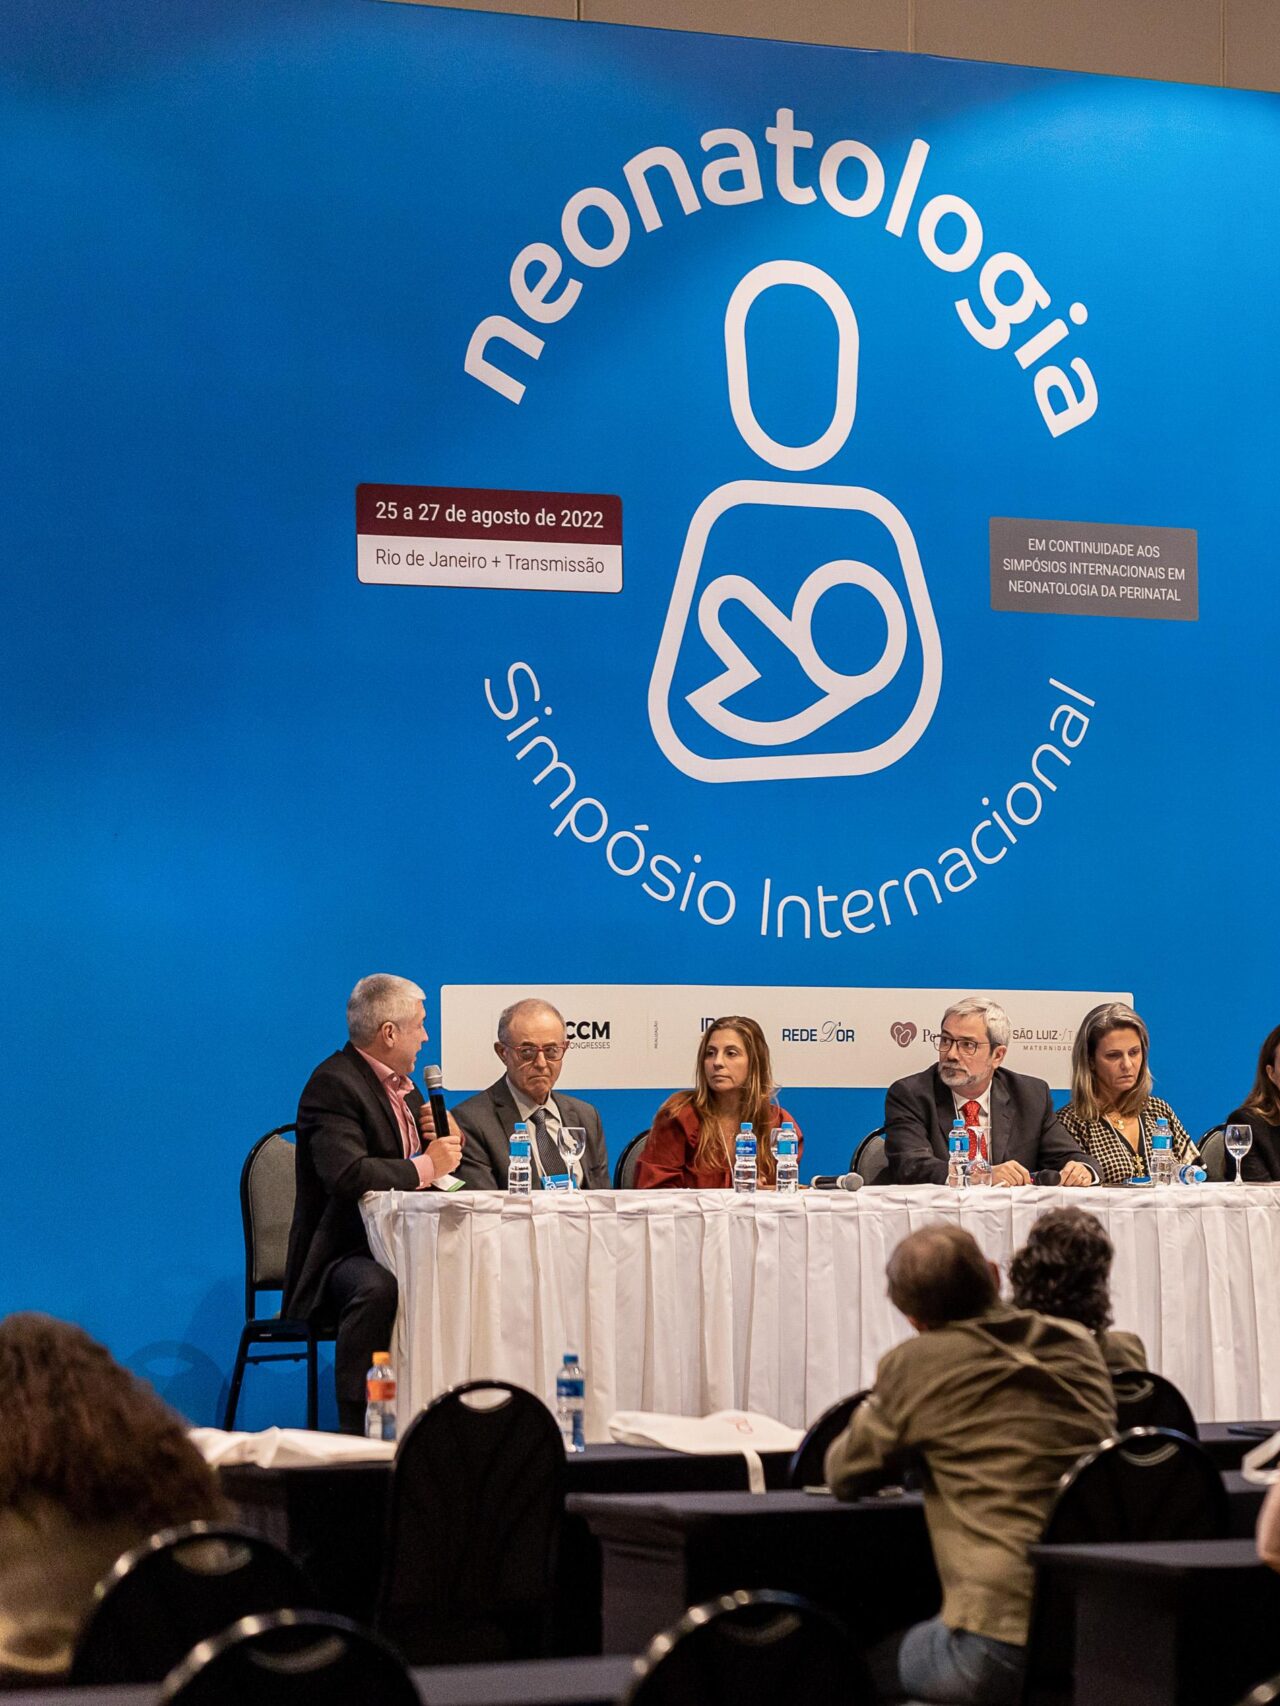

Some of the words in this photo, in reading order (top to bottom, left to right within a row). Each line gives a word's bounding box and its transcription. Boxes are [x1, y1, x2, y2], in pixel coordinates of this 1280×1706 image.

[464, 108, 1098, 438] neonatologia
[375, 502, 398, 519] 25
[403, 507, 413, 520] a
[418, 504, 440, 521] 27
[445, 504, 467, 523] de
[471, 509, 531, 528] agosto
[535, 508, 556, 526] de
[561, 510, 604, 528] 2022
[1028, 538, 1046, 551] EM
[1048, 539, 1134, 556] CONTINUIDADE
[1136, 545, 1160, 558] AOS
[375, 549, 401, 566] Rio
[405, 550, 425, 566] de
[429, 550, 487, 568] Janeiro
[492, 556, 502, 568] +
[505, 553, 605, 574] Transmissão
[1003, 557, 1067, 574] SIMPÓSIOS
[1069, 562, 1165, 580] INTERNACIONAIS
[1168, 567, 1185, 581] EM
[1008, 580, 1098, 597] NEONATOLOGIA
[1101, 585, 1115, 598] DA
[1119, 586, 1181, 602] PERINATAL
[485, 661, 736, 926] Simpósio
[760, 677, 1096, 939] Internacional
[782, 1028, 818, 1042] REDE
[1012, 1027, 1034, 1040] SÃO
[567, 1041, 611, 1050] ONGRESSES
